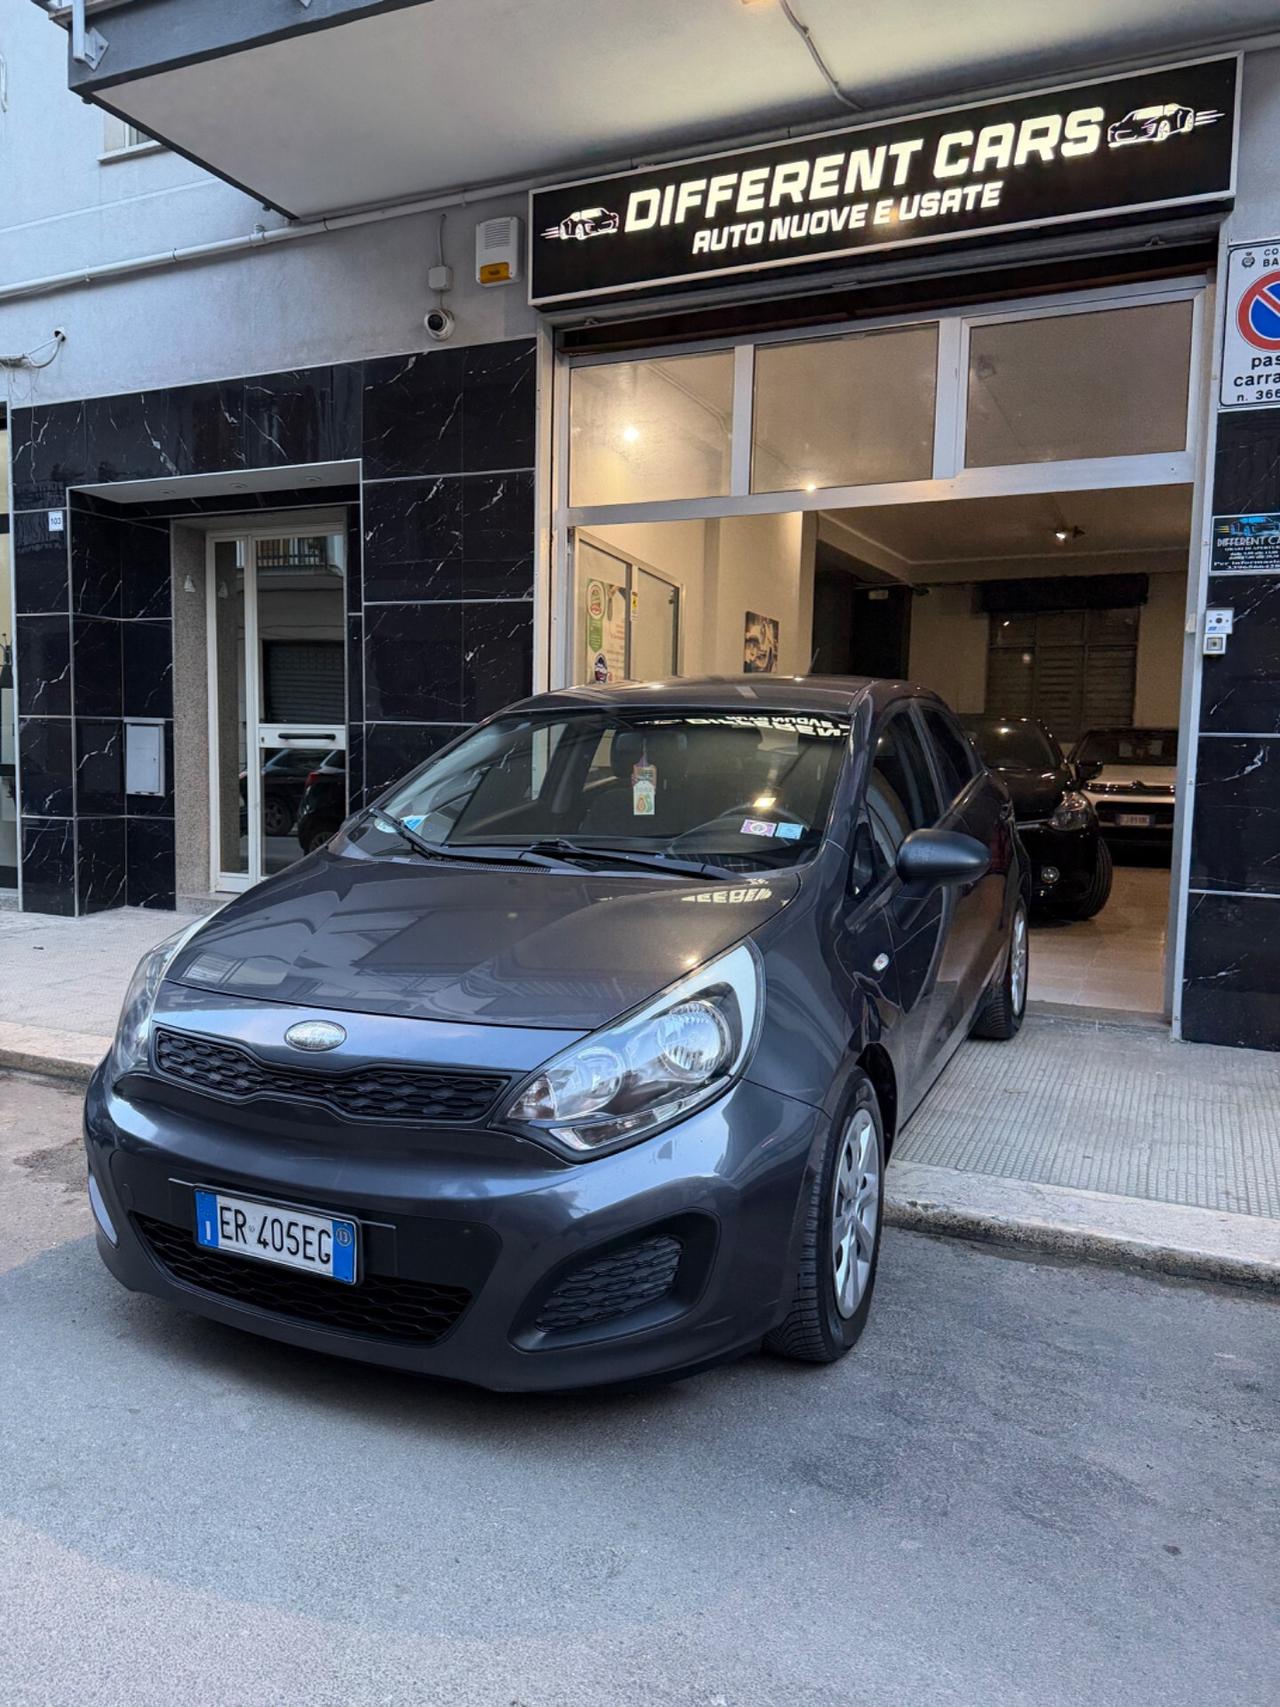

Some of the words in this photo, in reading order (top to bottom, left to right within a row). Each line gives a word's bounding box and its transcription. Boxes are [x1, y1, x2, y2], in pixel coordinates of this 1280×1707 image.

[624, 144, 922, 232] DIFFERENT
[933, 106, 1106, 180] CARS
[692, 221, 767, 255] AUTO
[769, 203, 867, 243] NUOVE
[873, 202, 890, 226] E
[898, 181, 1003, 221] USATE
[1264, 248, 1279, 256] CO
[1263, 257, 1279, 267] BA
[1251, 355, 1280, 370] pas
[1234, 374, 1280, 387] carra
[1237, 393, 1248, 402] n.
[1217, 537, 1265, 547] DIFFERENT
[219, 1206, 247, 1244] ER
[257, 1216, 331, 1264] 405EG
